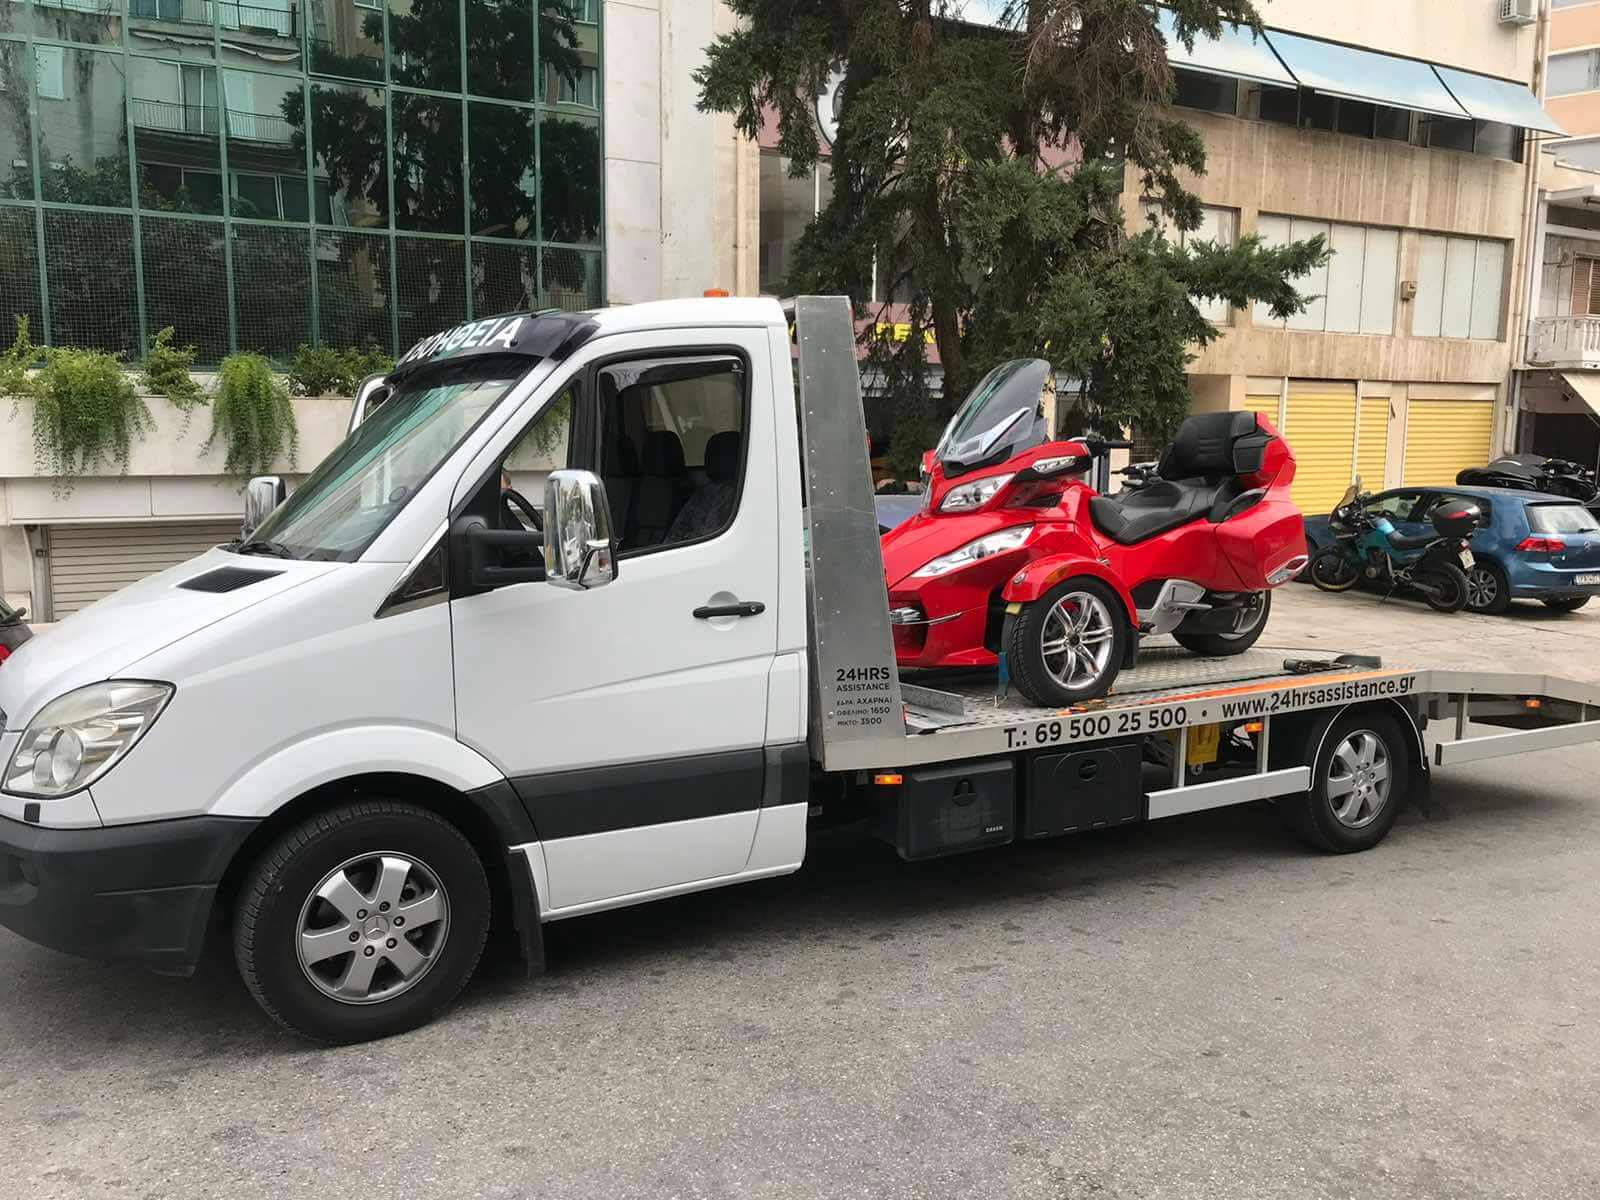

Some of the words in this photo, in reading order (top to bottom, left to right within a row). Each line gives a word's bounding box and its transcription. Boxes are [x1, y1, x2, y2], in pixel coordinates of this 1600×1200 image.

[836, 667, 890, 682] 24HRS
[836, 682, 890, 692] ASSISTANCE
[870, 706, 890, 714] 1650
[1035, 721, 1062, 744] 69
[1069, 715, 1111, 739] 500
[1117, 711, 1141, 733] 25
[1148, 706, 1187, 729] 500
[1221, 675, 1416, 718] www.24hrsassistance.gr
[860, 717, 882, 725] 3500
